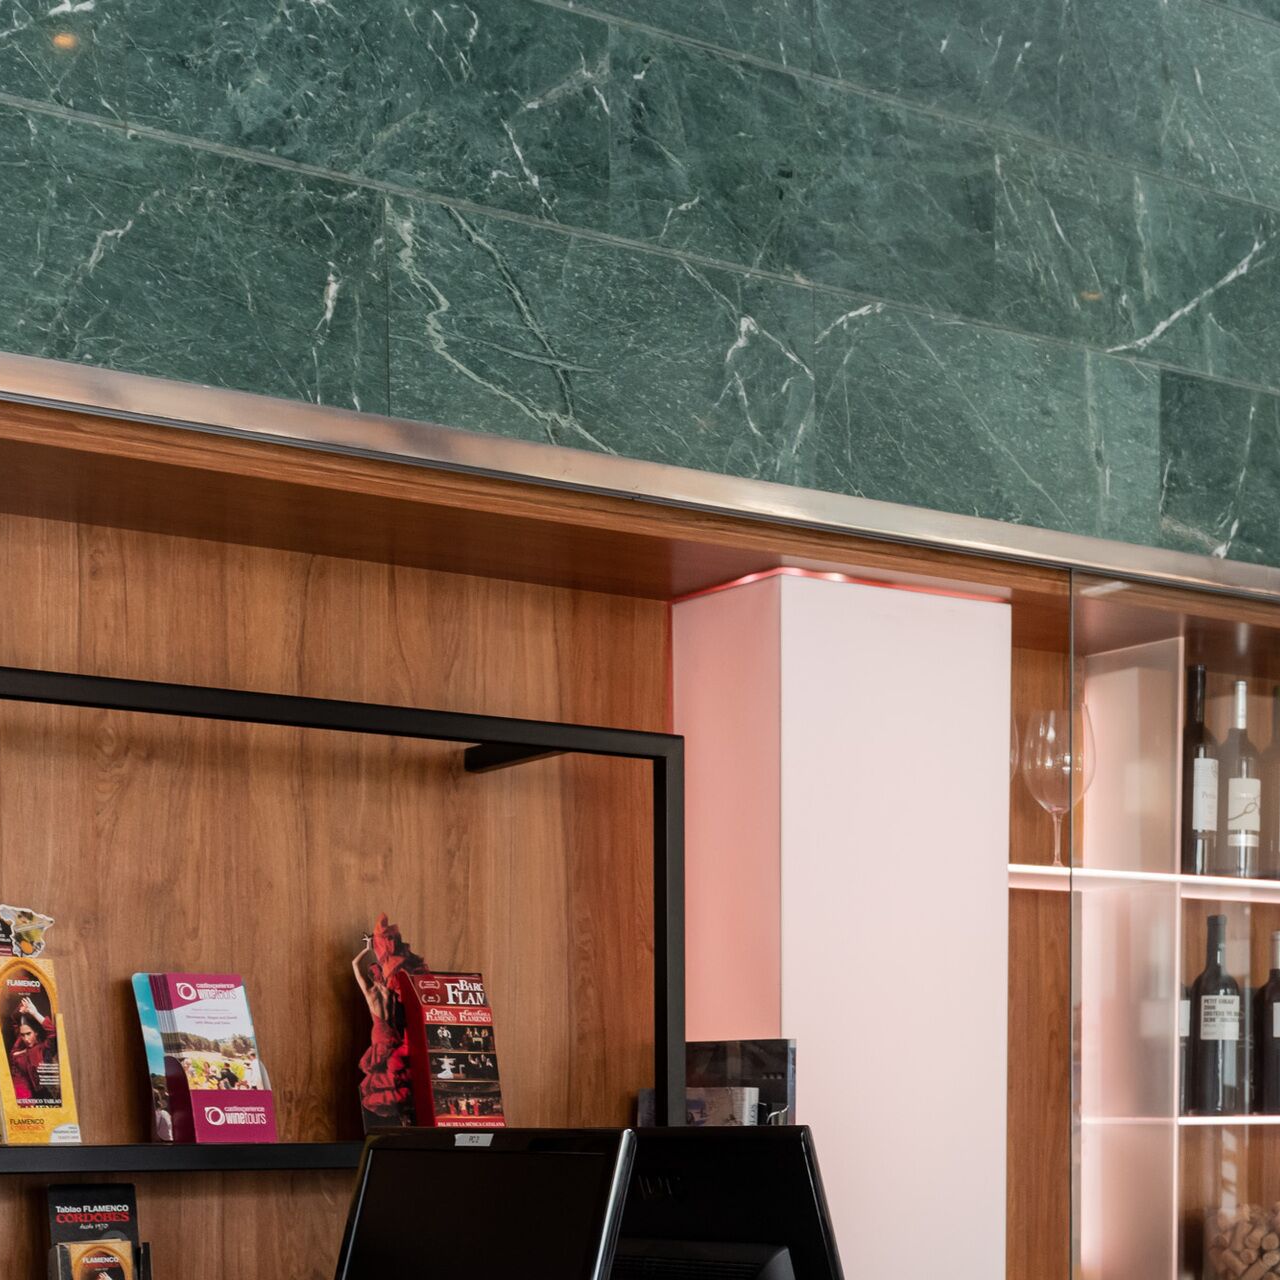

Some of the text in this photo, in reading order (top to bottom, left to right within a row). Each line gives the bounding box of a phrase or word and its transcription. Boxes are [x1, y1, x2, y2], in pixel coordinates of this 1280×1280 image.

[6, 980, 40, 988] FLAMENCO
[224, 1113, 267, 1125] winetours
[55, 1204, 129, 1213] Tablao FLAMENCO
